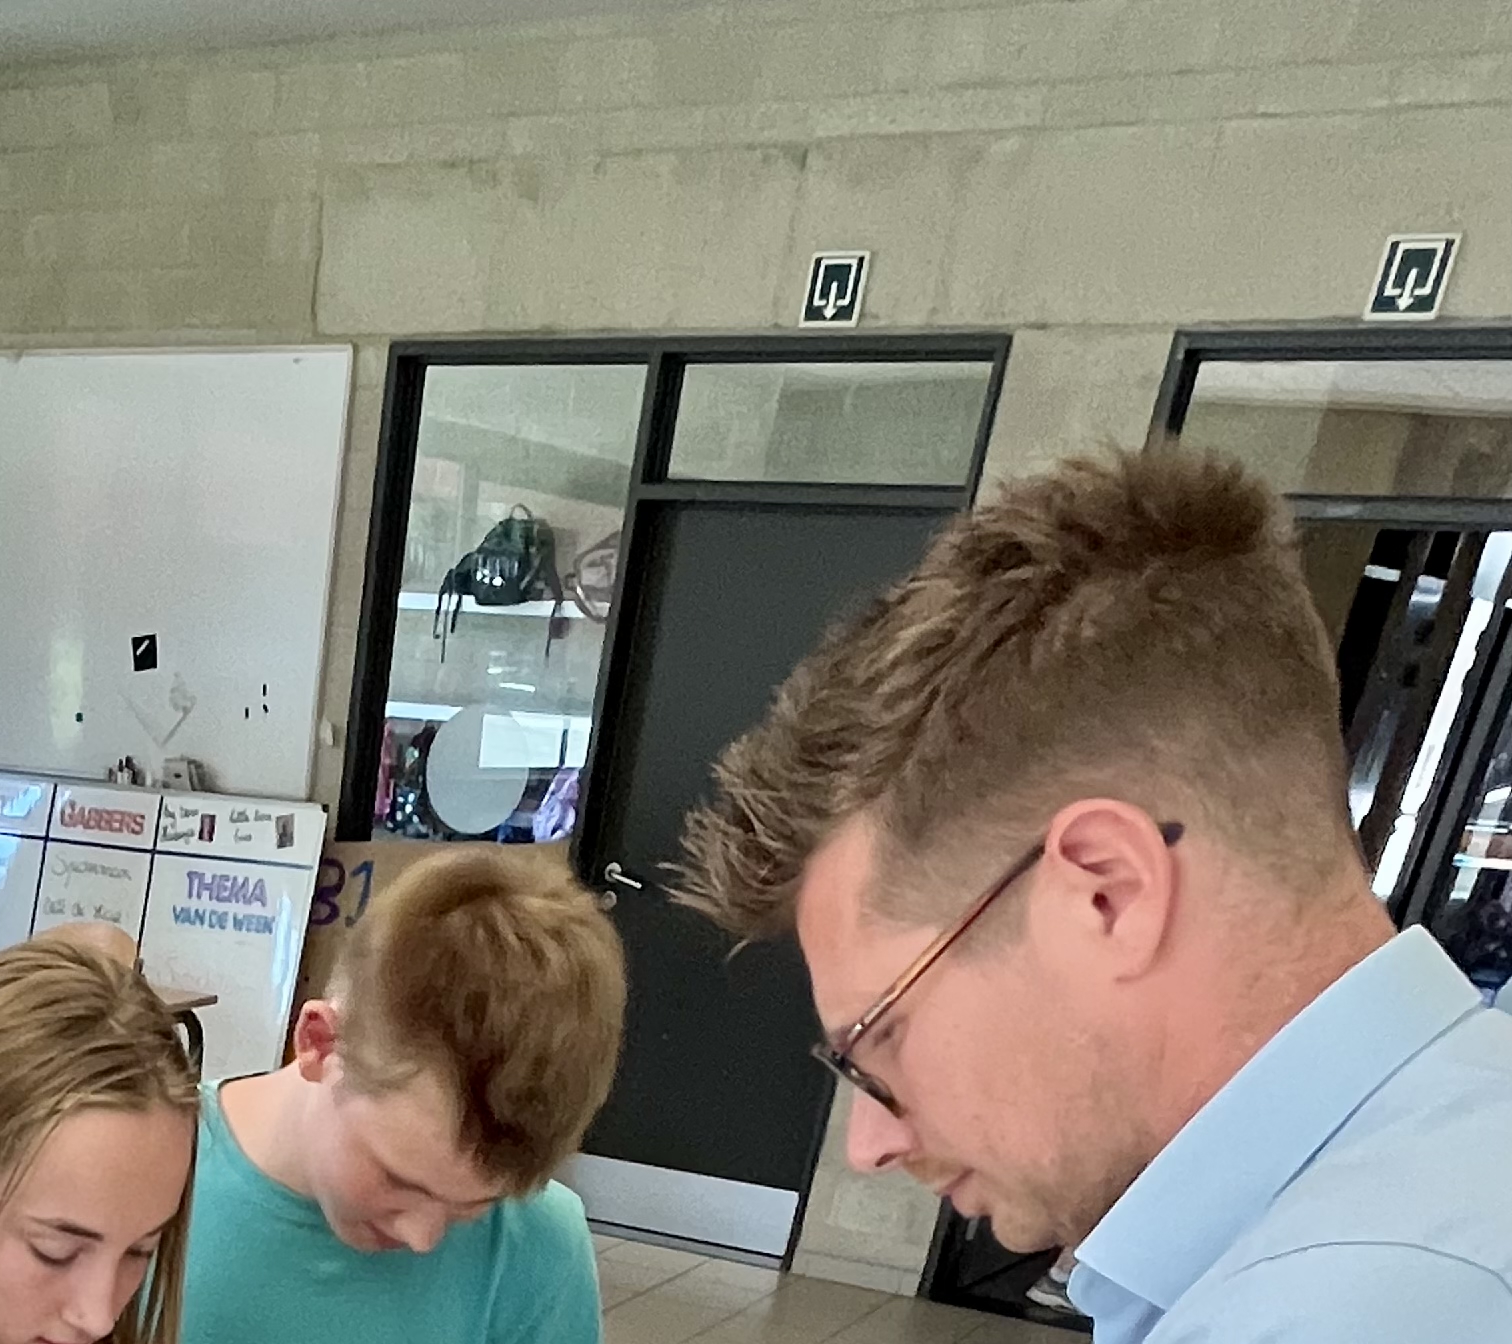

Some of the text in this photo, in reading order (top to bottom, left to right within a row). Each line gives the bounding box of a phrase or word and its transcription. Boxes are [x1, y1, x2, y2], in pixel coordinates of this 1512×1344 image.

[186, 870, 267, 907] THEMA
[173, 904, 275, 935] VAN DE WEEK
